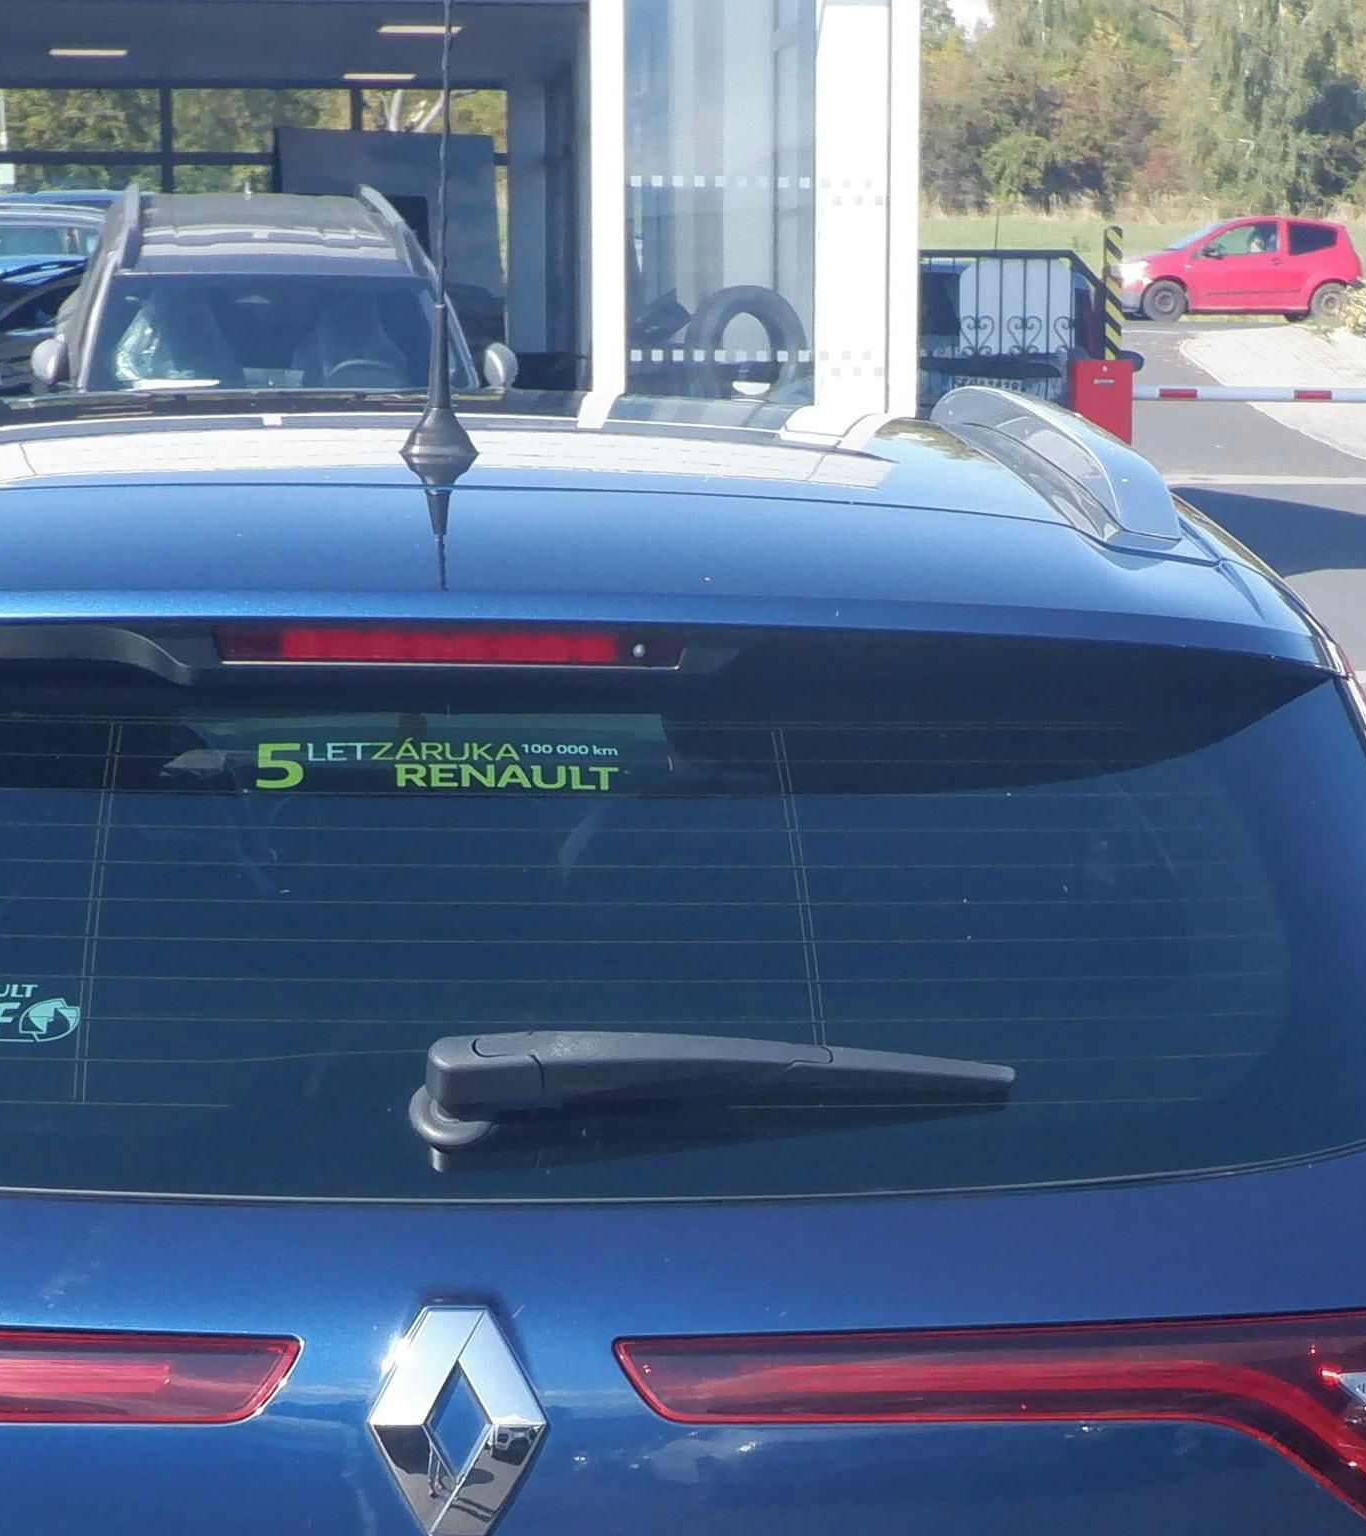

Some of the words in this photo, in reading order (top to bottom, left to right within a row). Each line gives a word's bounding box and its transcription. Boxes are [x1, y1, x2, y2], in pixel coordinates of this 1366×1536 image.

[255, 742, 304, 789] 5
[521, 743, 552, 755] 100
[556, 744, 589, 756] 000
[592, 745, 619, 757] km
[394, 763, 620, 791] RENAULT
